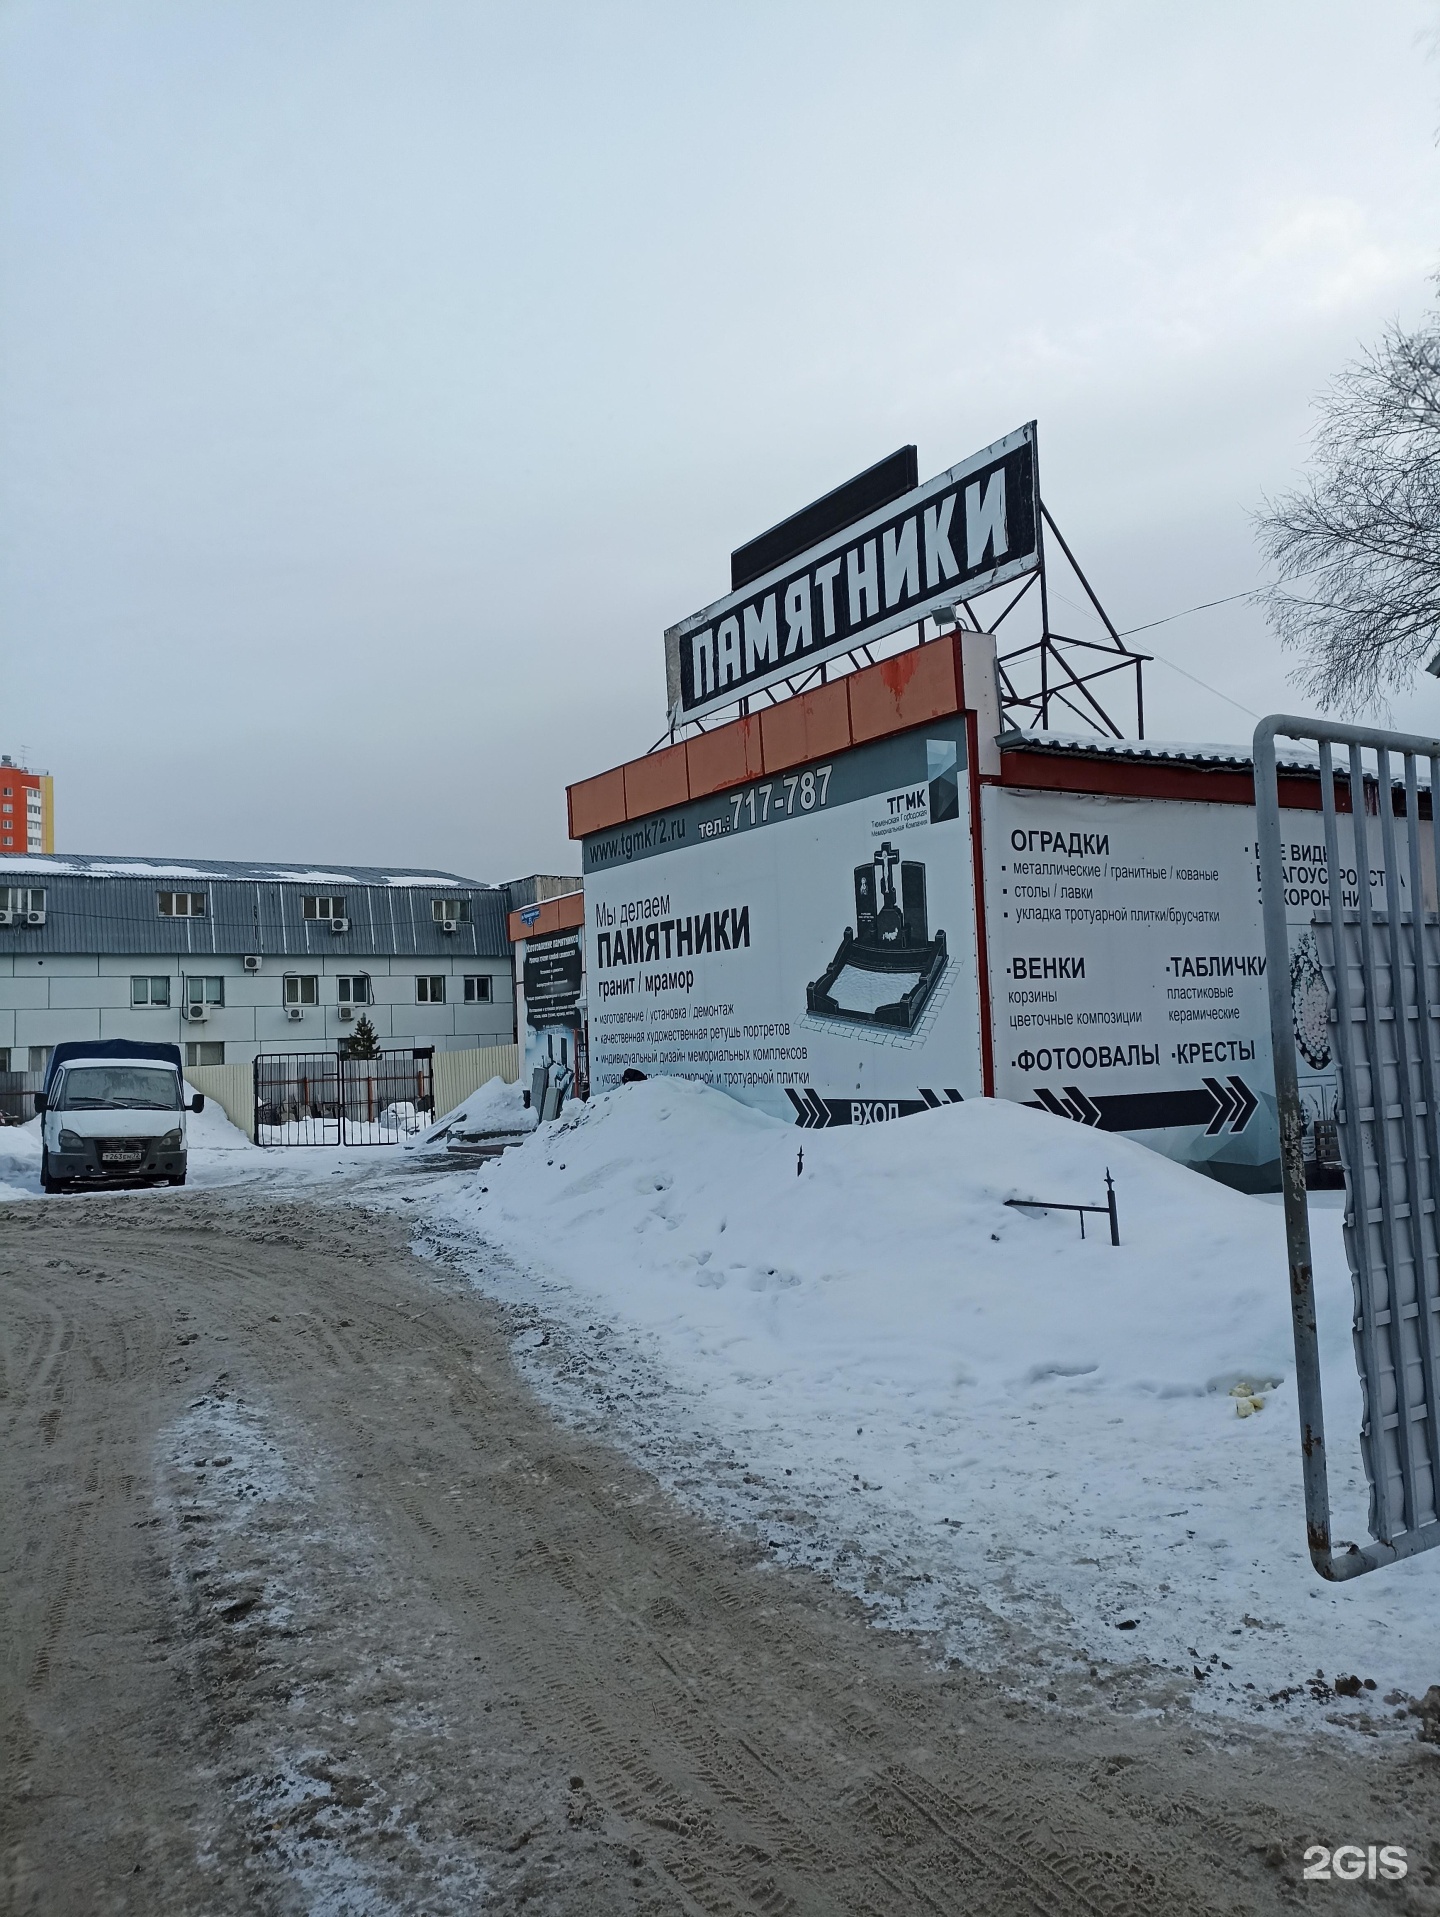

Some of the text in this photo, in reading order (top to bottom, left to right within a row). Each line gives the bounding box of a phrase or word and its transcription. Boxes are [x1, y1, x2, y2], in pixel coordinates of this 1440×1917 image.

[692, 466, 1009, 700] ПАМЯТНИКИ
[887, 789, 926, 814] ТГМК
[589, 818, 686, 863] www.tgmk72.ru
[1010, 829, 1110, 858] ОГРАДКИ
[1013, 861, 1100, 878] металлические
[1110, 865, 1167, 881] гранитные
[1176, 867, 1219, 881] кованые
[1014, 885, 1050, 899] столы
[1060, 886, 1093, 899] лавки
[596, 894, 670, 928] Мы делаем
[1016, 907, 1220, 925] укладка тротуарной плитки/брусчатки
[597, 905, 750, 969] ПАМЯТНИКИ
[1013, 957, 1086, 979] ВЕНКИ
[598, 977, 635, 1002] гранит
[645, 969, 694, 997] мрамор
[1167, 985, 1234, 1000] пластиковые
[1008, 990, 1058, 1006] корзины
[599, 1010, 644, 1025] изготовление
[650, 1007, 687, 1025] установка
[693, 1003, 735, 1019] демонтаж
[1009, 1010, 1143, 1030] цветочные композиции
[1168, 1006, 1240, 1023] керамические
[600, 1023, 790, 1045] качественная художественная ретушь портретов
[600, 1047, 808, 1066] индивидуальный дизайн мемориальных комплексов
[1017, 1043, 1160, 1072] ФОТООВАЛЫ
[1176, 1040, 1255, 1064] КРЕСТЫ
[724, 1069, 774, 1088] тротуарной
[776, 1072, 810, 1085] плитки
